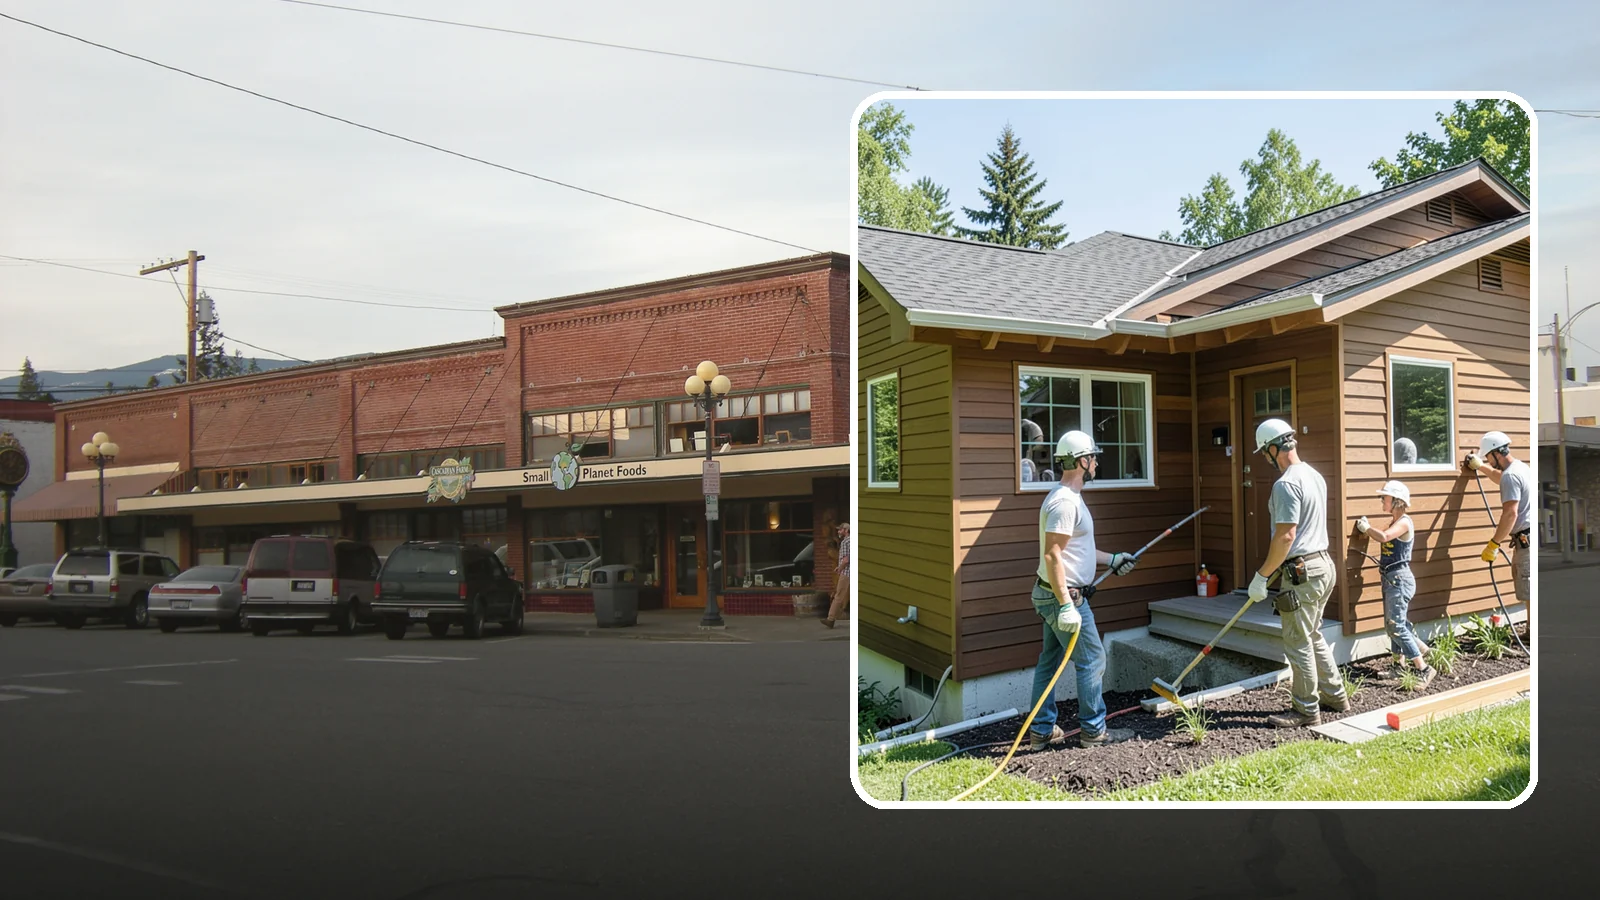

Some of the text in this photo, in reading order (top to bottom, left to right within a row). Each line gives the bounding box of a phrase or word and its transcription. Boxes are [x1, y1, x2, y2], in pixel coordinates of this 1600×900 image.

[523, 464, 647, 483] Small Planet Foods
